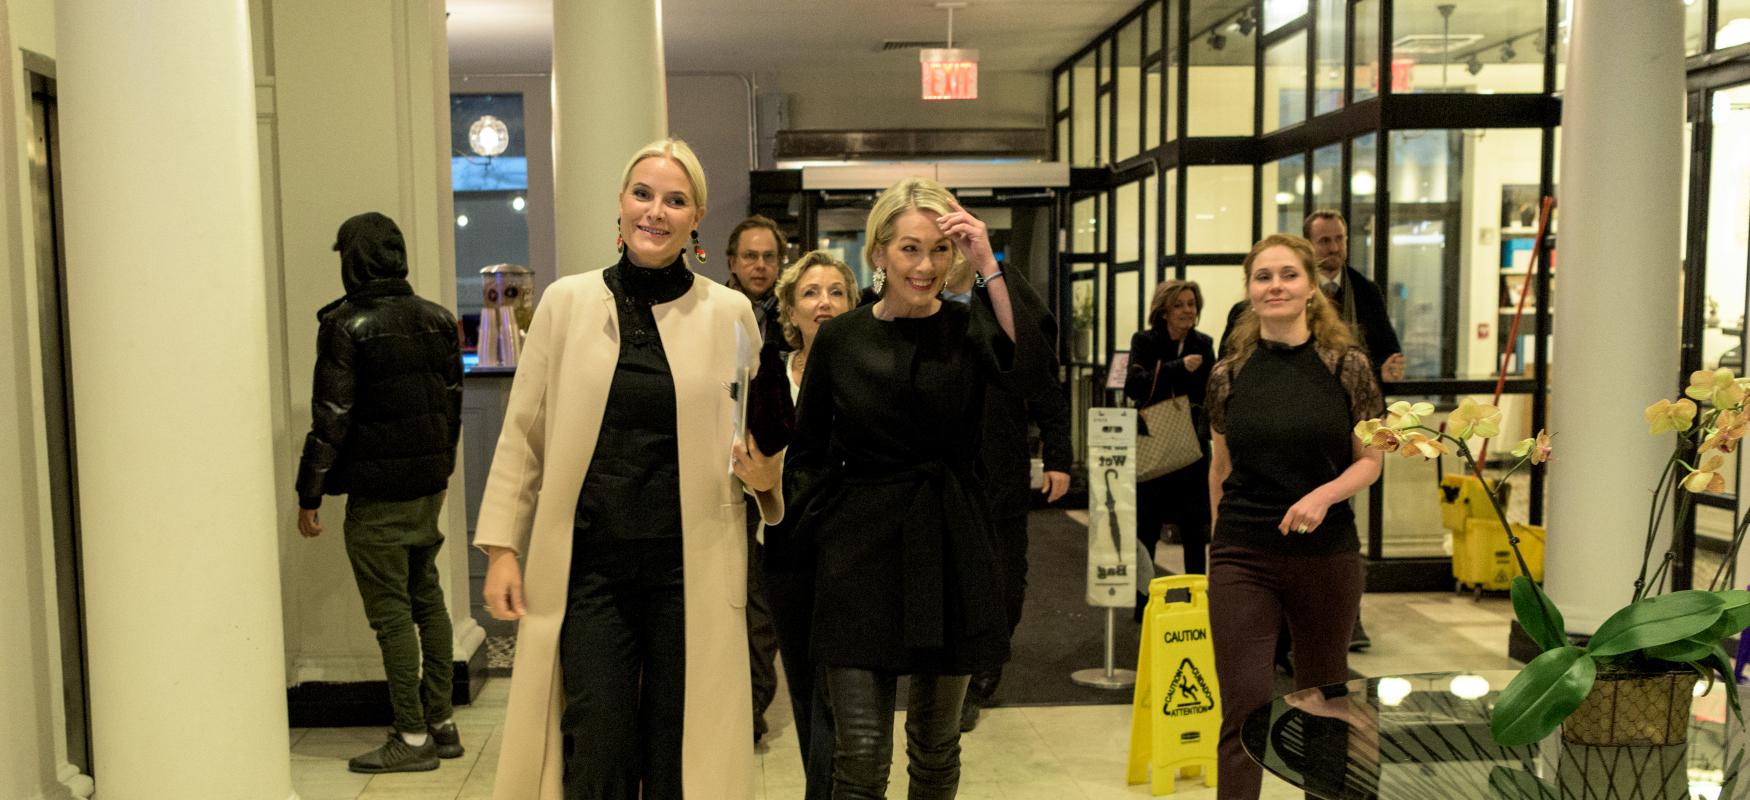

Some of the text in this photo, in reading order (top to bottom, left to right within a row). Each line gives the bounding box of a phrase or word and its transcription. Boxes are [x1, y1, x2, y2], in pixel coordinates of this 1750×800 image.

[929, 63, 972, 97] EXIT
[1164, 628, 1207, 644] CAUTION
[1164, 668, 1183, 703] CAUTION
[1193, 667, 1212, 698] CUIDADO
[1170, 706, 1208, 717] ATTENTION
